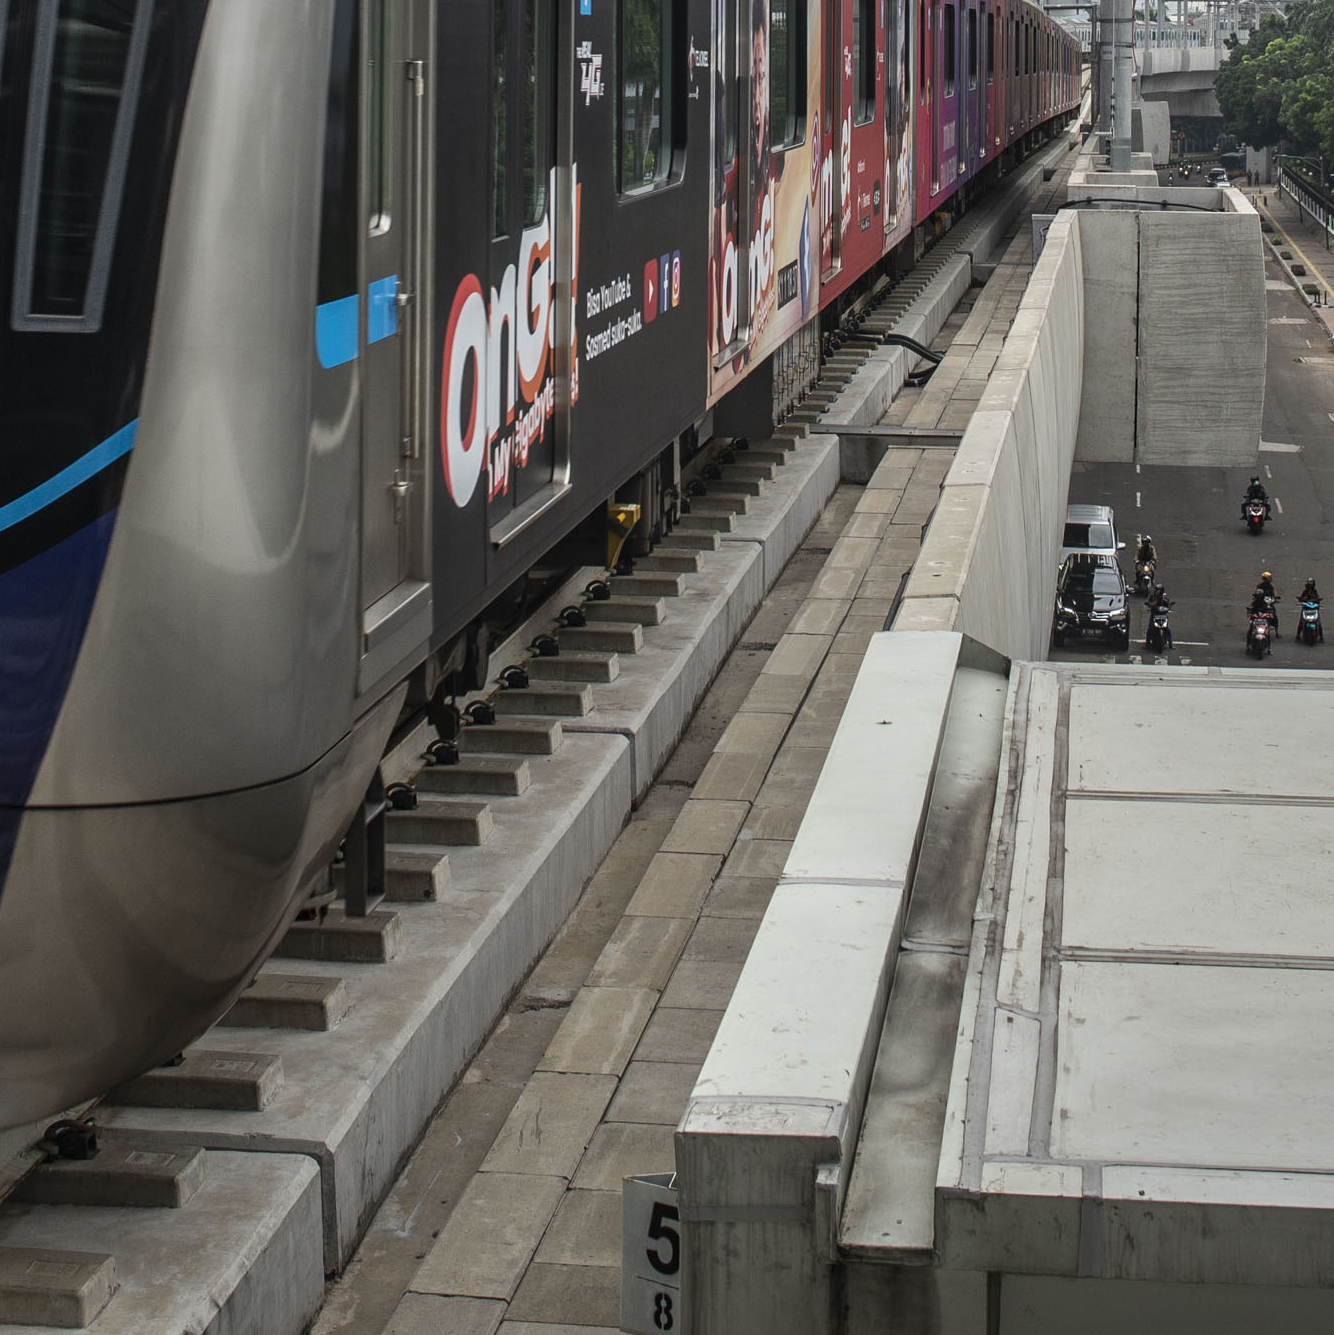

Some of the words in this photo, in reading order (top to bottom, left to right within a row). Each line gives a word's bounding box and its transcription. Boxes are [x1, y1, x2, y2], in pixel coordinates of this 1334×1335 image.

[587, 287, 601, 318] Bisa
[600, 277, 626, 311] YouTube
[585, 322, 611, 361] Sosmed
[646, 1201, 680, 1275] 5
[654, 1292, 674, 1331] 8
